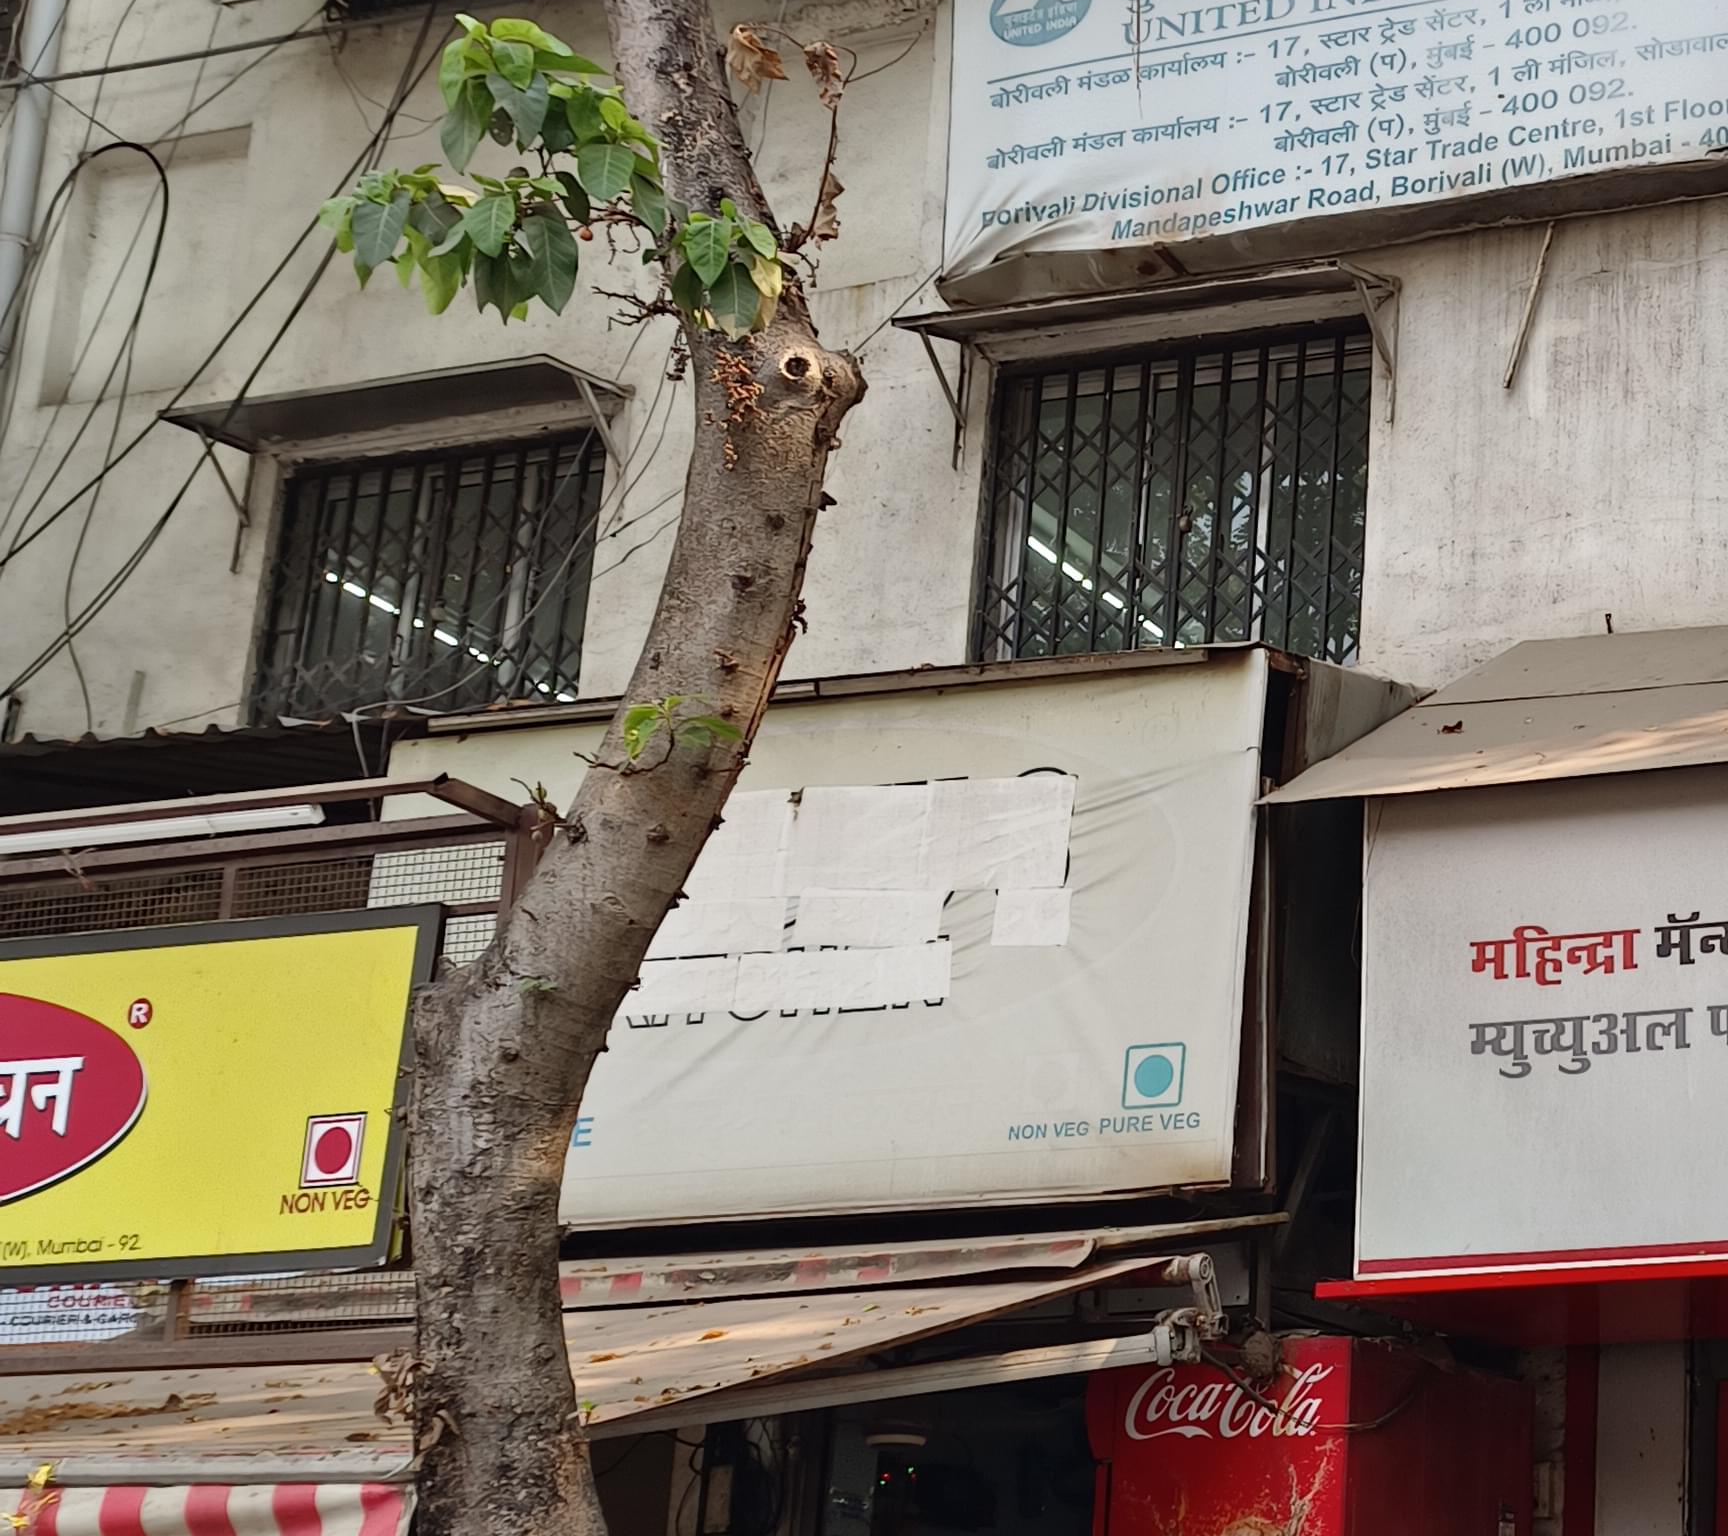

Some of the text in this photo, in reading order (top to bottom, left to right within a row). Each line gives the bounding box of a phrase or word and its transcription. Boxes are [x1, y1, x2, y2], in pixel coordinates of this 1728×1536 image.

[1003, 14, 1078, 40] UNITED INDIA
[1274, 55, 1361, 89] बोरीवली
[1424, 32, 1477, 69] मुंबई
[1503, 23, 1562, 49] 400
[990, 76, 1073, 110] बोरीवली
[1077, 69, 1133, 92] मंडळ
[1137, 50, 1229, 82] कार्यालय
[1318, 23, 1372, 50] स्टार
[1377, 16, 1420, 45] ट्रेड
[985, 136, 1068, 171] बोरीवली
[1072, 129, 1127, 152] मंडल
[1131, 111, 1222, 144] कार्यालय
[1309, 91, 1363, 116] स्टार
[1369, 82, 1410, 112] ट्रेड
[1512, 58, 1543, 82] ली
[1273, 120, 1361, 154] बोरीवली
[1423, 99, 1474, 136] मुंबई
[1500, 89, 1560, 116] 400
[1080, 177, 1203, 214] Divisional
[1210, 166, 1287, 195] Office
[1364, 144, 1419, 170] Star
[1425, 131, 1499, 161] Trade
[1507, 116, 1605, 147] Centre,
[1614, 105, 1656, 130] 1st
[1110, 194, 1301, 242] Mandapeshwar
[1307, 179, 1382, 209] Road,
[1390, 161, 1493, 198] Borivali
[1563, 131, 1673, 171] Mumbai
[1469, 924, 1642, 987] महिन्द्रा
[1469, 1005, 1695, 1078] म्युच्युअल
[1007, 1111, 1201, 1142] NON VEG PURE VEG
[279, 1187, 371, 1216] NON VEG
[118, 1233, 143, 1252] 92
[47, 1294, 133, 1309] COURIE
